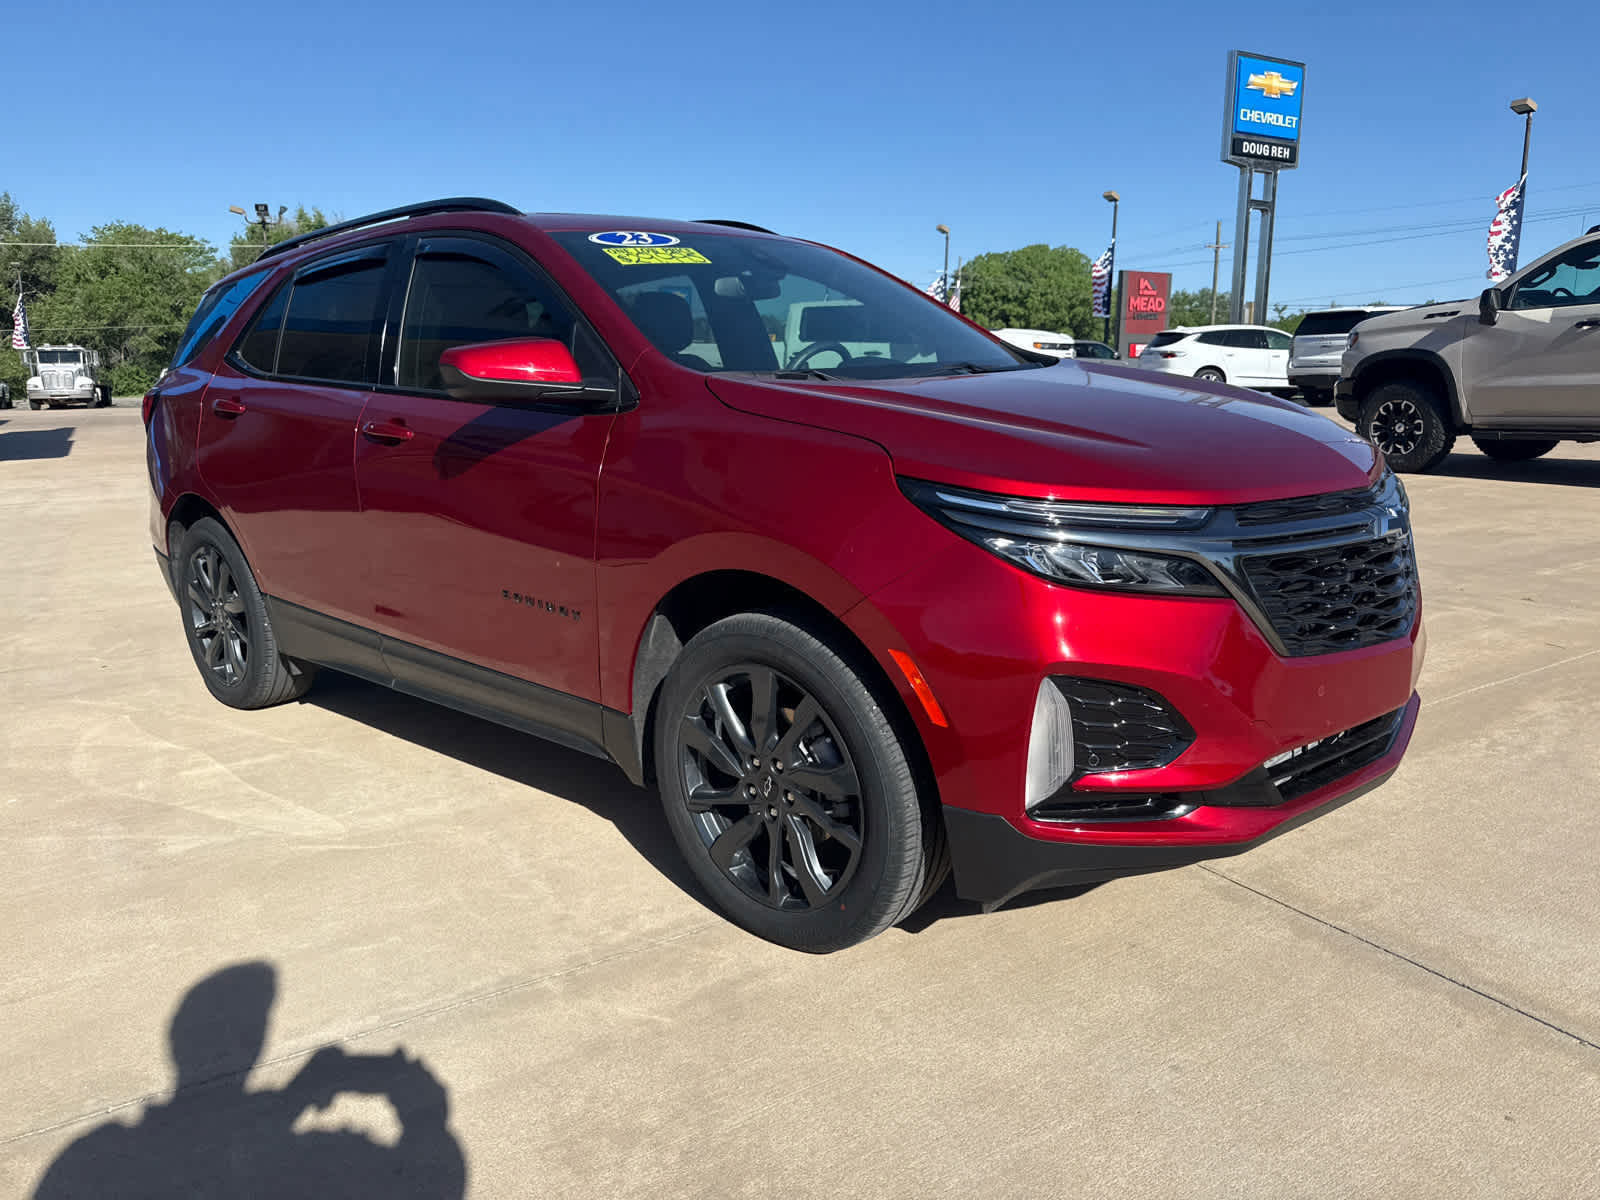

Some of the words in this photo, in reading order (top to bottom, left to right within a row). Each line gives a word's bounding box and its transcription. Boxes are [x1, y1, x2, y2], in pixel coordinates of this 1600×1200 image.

[1240, 108, 1298, 128] CHEVROLET
[1242, 141, 1270, 156] DOUG
[1270, 146, 1290, 159] REH
[616, 231, 653, 244] 23
[1129, 296, 1166, 312] MEAD
